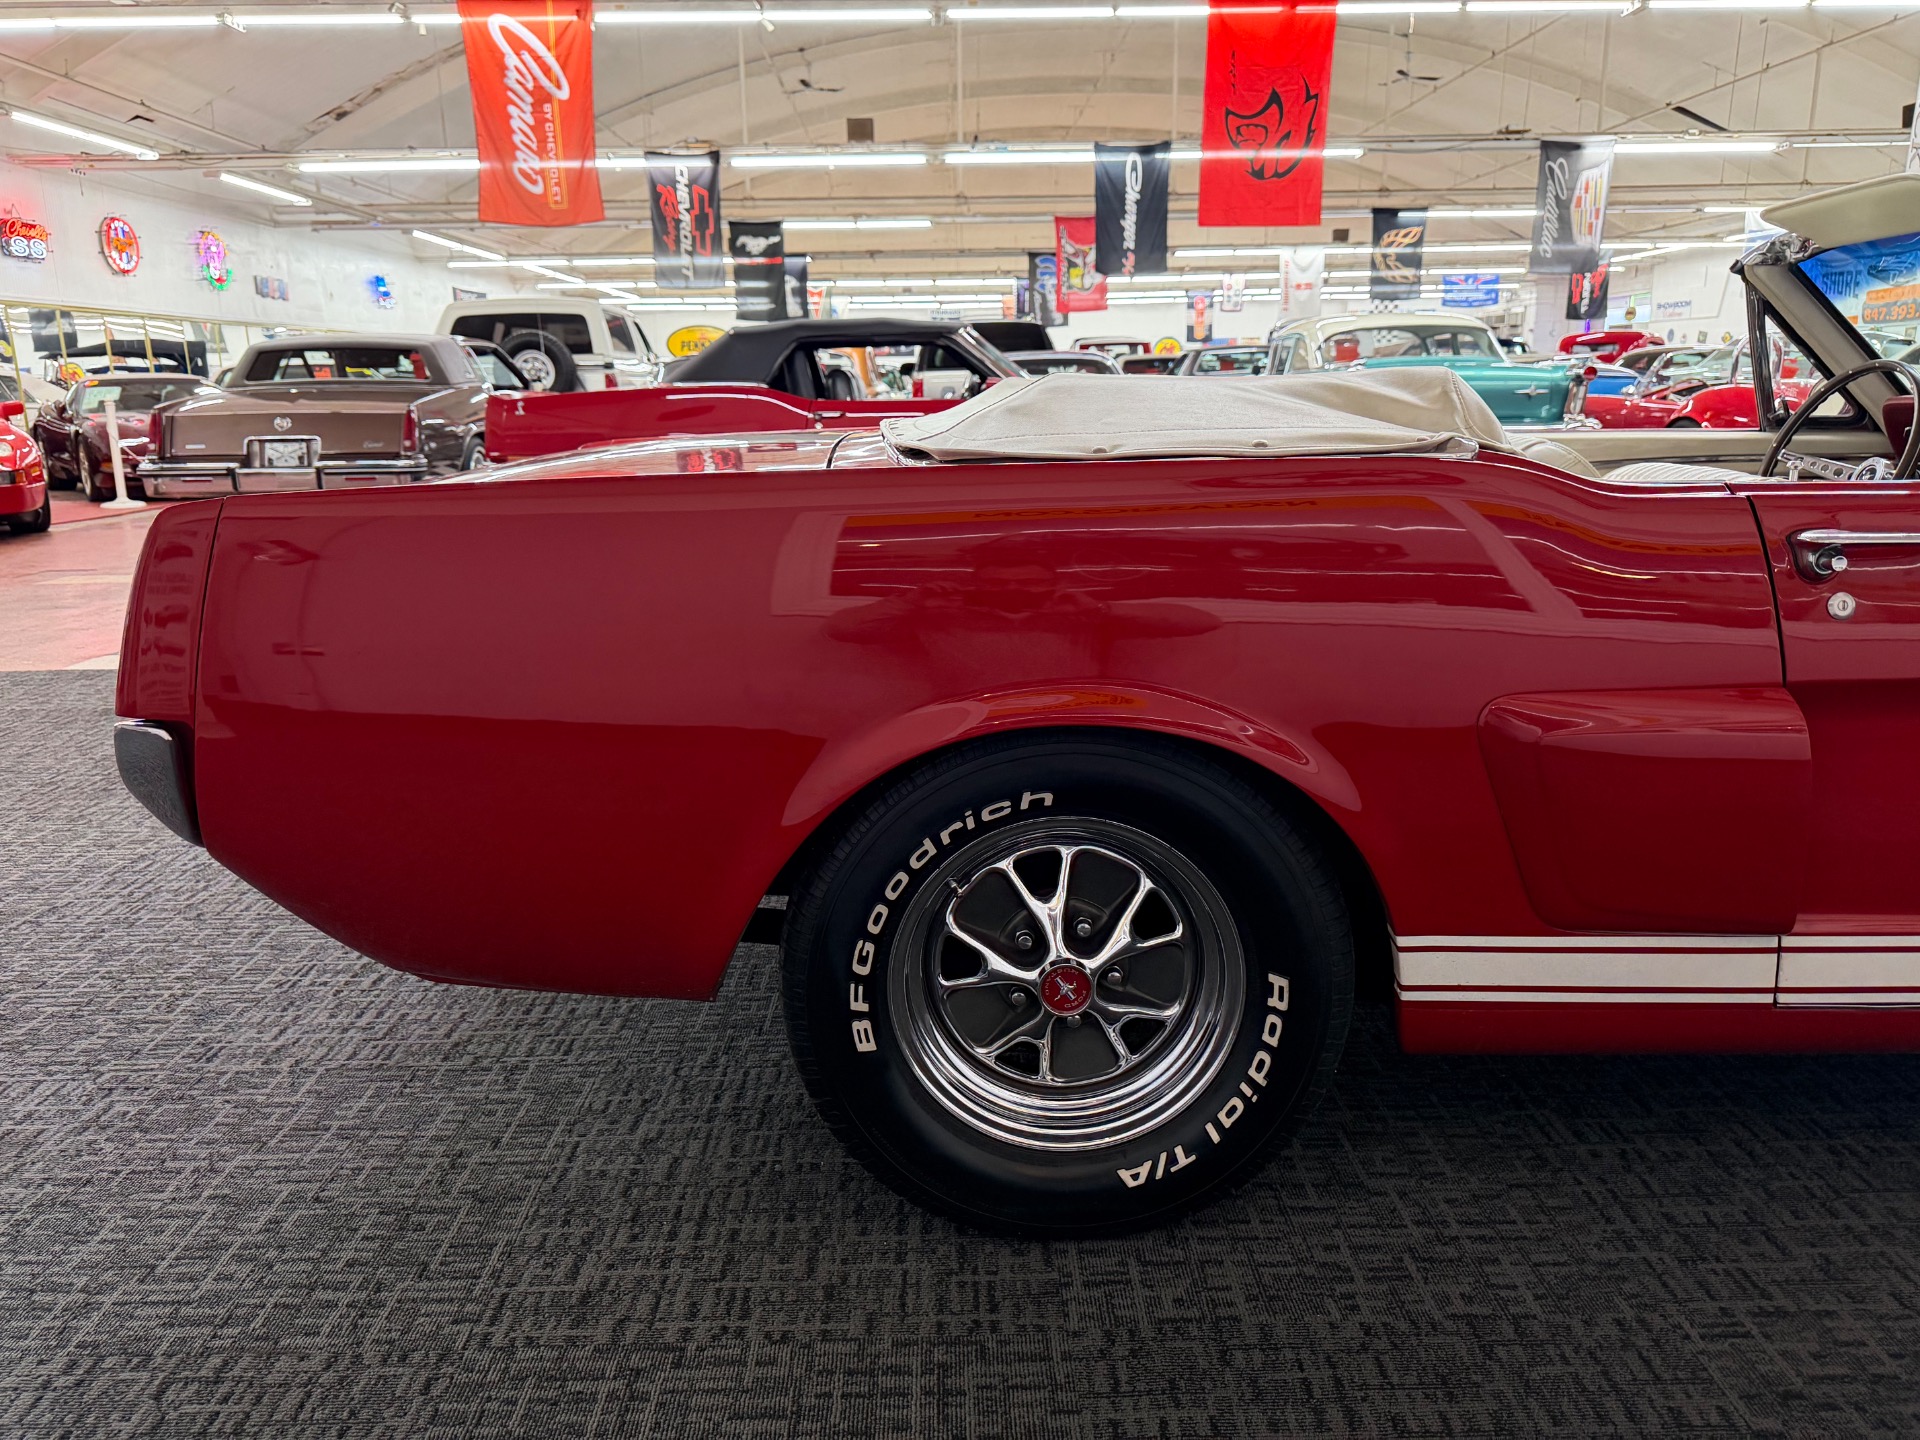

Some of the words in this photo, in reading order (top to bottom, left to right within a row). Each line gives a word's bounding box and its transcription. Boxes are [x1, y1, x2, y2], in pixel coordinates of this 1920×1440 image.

[487, 13, 570, 195] Camaro
[542, 103, 554, 121] BY
[674, 164, 694, 281] CHEVROLET
[1120, 152, 1143, 250] Charger
[1540, 157, 1569, 258] Cadillac
[10, 235, 48, 259] SS
[1821, 270, 1863, 300] SHORE
[850, 791, 1054, 1052] BFGoodrich
[1045, 968, 1079, 996] MUSTANG
[1064, 990, 1087, 1008] FORD
[1204, 972, 1290, 1145] Radial
[1116, 1144, 1197, 1189] T/A
